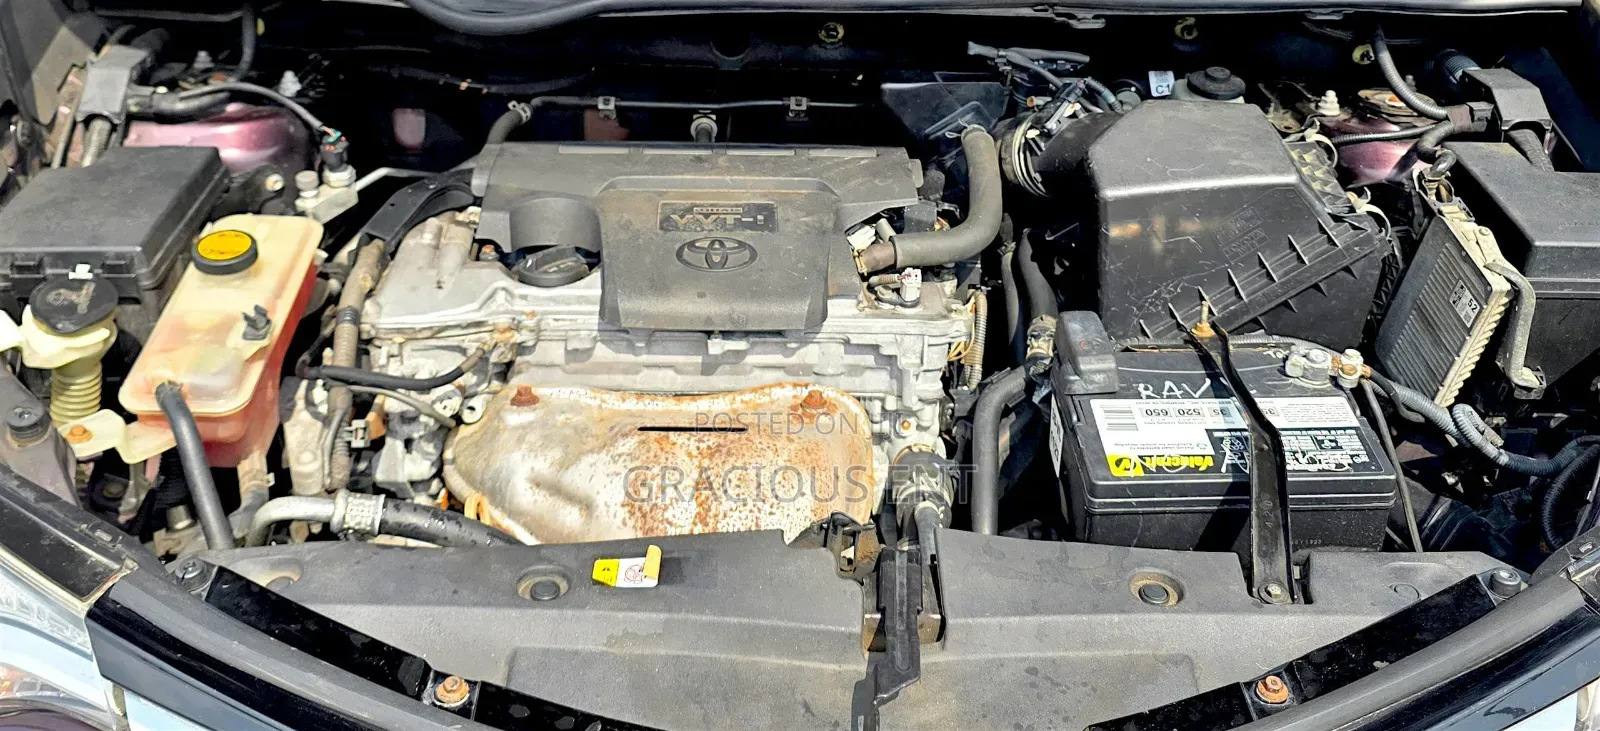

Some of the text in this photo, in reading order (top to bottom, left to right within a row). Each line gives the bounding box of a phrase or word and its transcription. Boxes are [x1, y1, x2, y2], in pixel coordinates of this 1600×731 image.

[1467, 298, 1478, 314] 52
[1137, 377, 1211, 399] RAV
[1145, 408, 1169, 416] 650
[1177, 408, 1201, 416] 520
[1212, 408, 1227, 416] 35
[1143, 455, 1215, 472] Valucraft
